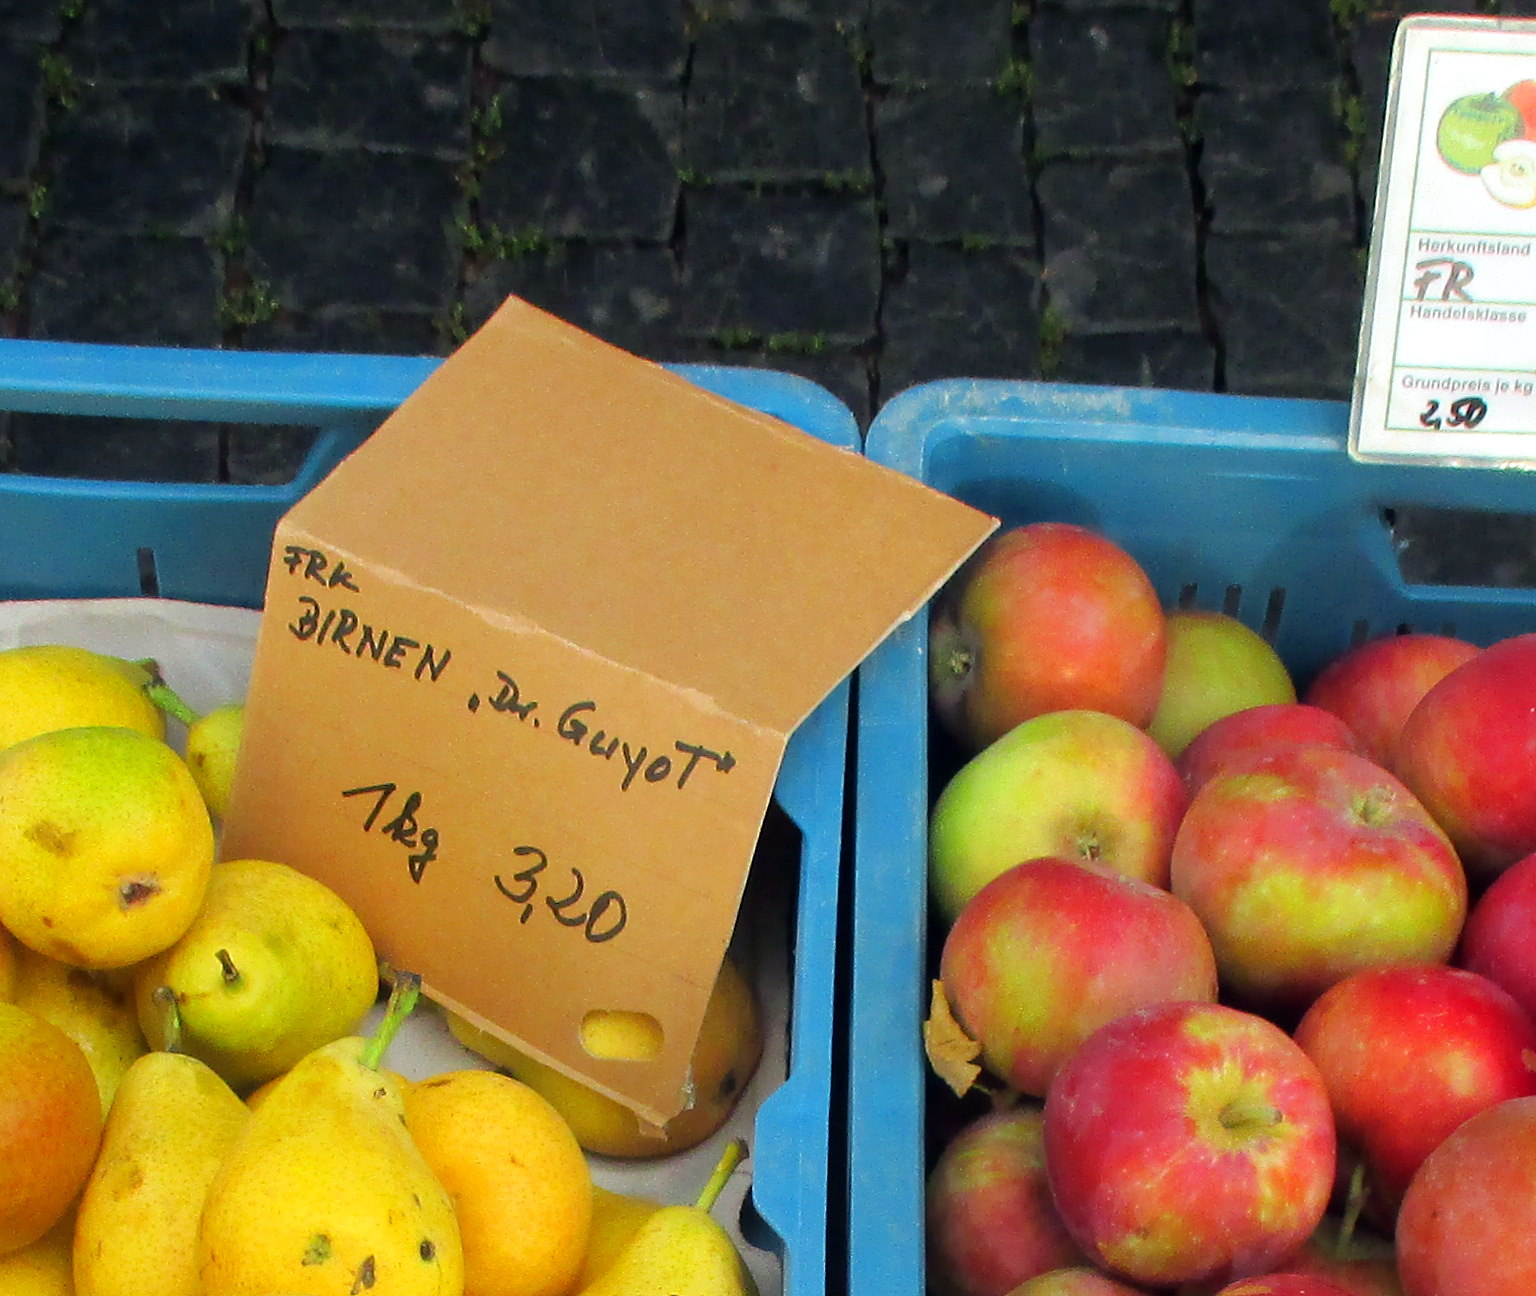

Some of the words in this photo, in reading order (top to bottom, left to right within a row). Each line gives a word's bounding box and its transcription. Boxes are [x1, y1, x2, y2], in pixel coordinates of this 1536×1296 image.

[1417, 237, 1531, 257] Herkunftsland
[1414, 257, 1474, 302] FR
[1410, 304, 1527, 323] Handelsklasse
[1401, 374, 1491, 393] Grundpreis
[1495, 376, 1510, 395] je
[1515, 378, 1533, 397] kg
[289, 596, 452, 682] BIRNEN
[494, 846, 628, 942] 3,20
